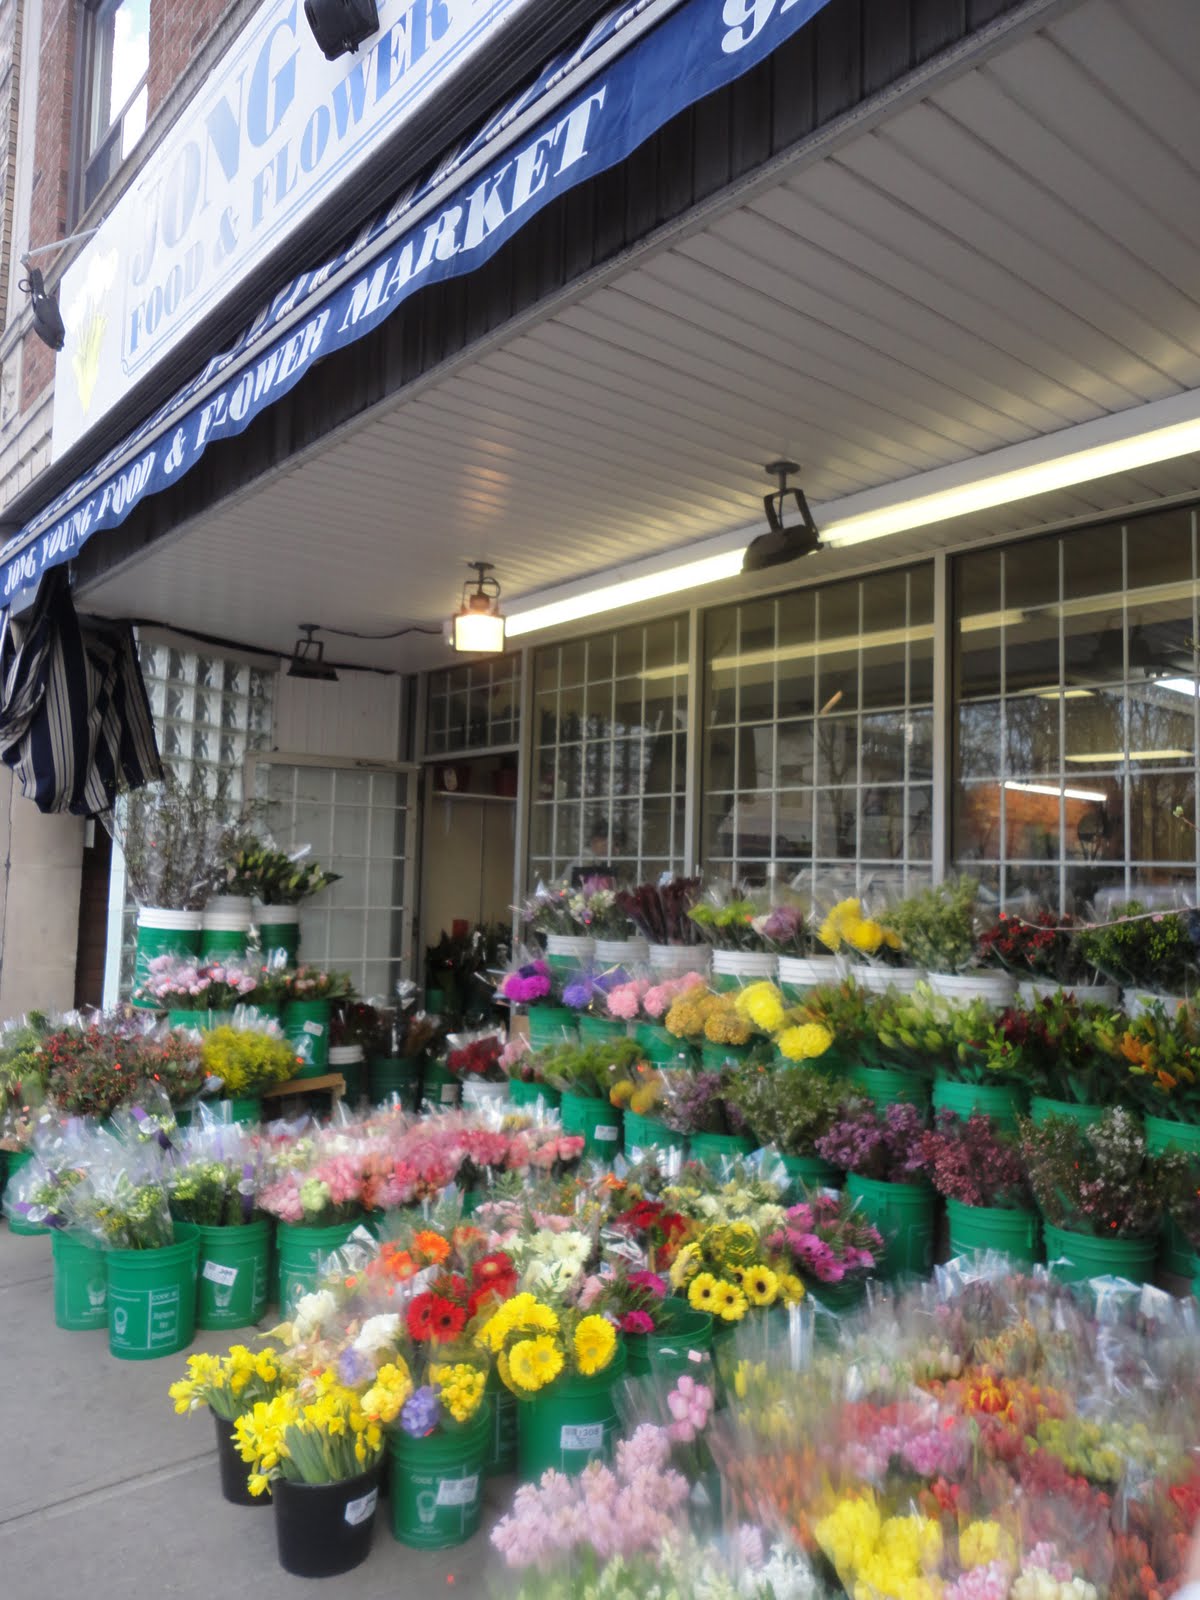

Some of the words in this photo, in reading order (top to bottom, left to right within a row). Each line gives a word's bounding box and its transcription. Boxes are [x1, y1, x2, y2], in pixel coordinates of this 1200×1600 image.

[130, 240, 204, 354] FOOD
[212, 206, 240, 269] &
[252, 0, 453, 232] FLOWER
[132, 0, 300, 286] JONG
[4, 547, 37, 596] JONG
[41, 500, 95, 566] YOUNG
[95, 452, 156, 522] FOOD
[164, 427, 186, 474] &
[194, 309, 330, 450] FLOWER
[337, 86, 606, 333] MARKET
